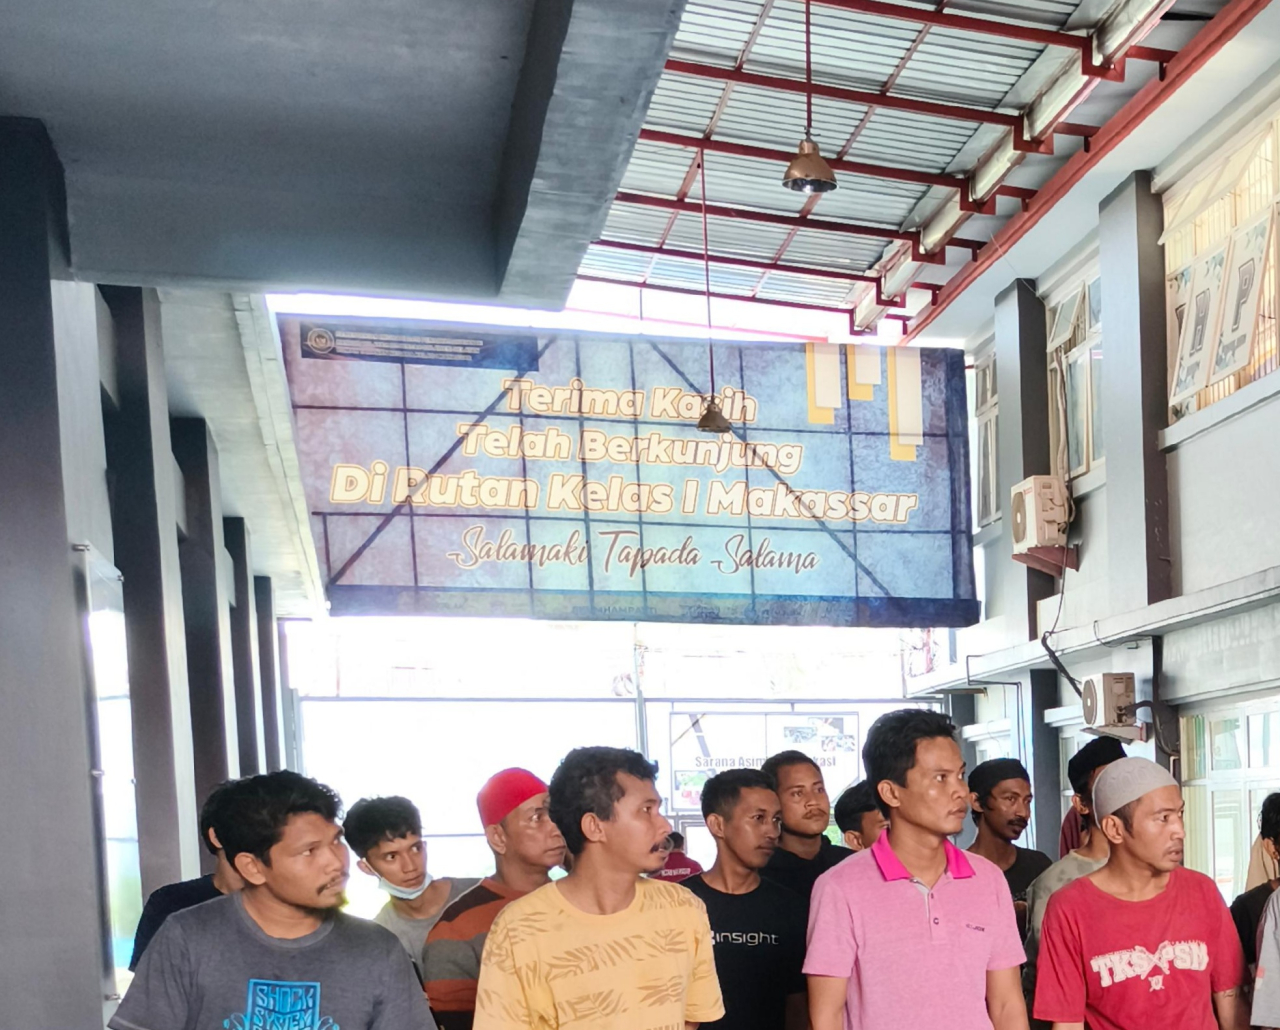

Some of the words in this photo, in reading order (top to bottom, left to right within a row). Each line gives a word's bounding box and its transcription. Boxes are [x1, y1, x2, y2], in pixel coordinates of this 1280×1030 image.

[503, 378, 645, 417] Terima
[651, 386, 758, 421] Kaih
[459, 424, 571, 461] Telah
[577, 429, 803, 475] Berkunjung
[330, 460, 388, 504] Di
[392, 467, 540, 509] Rutan
[547, 473, 674, 513] Kelas
[682, 479, 699, 514] I
[706, 479, 918, 524] Makassar
[447, 525, 591, 569] Salamaki
[598, 530, 702, 578] Tapada
[711, 533, 820, 575] Salama
[695, 756, 736, 768] Sarana
[716, 931, 779, 946] insight
[256, 986, 315, 1012] SHOCK
